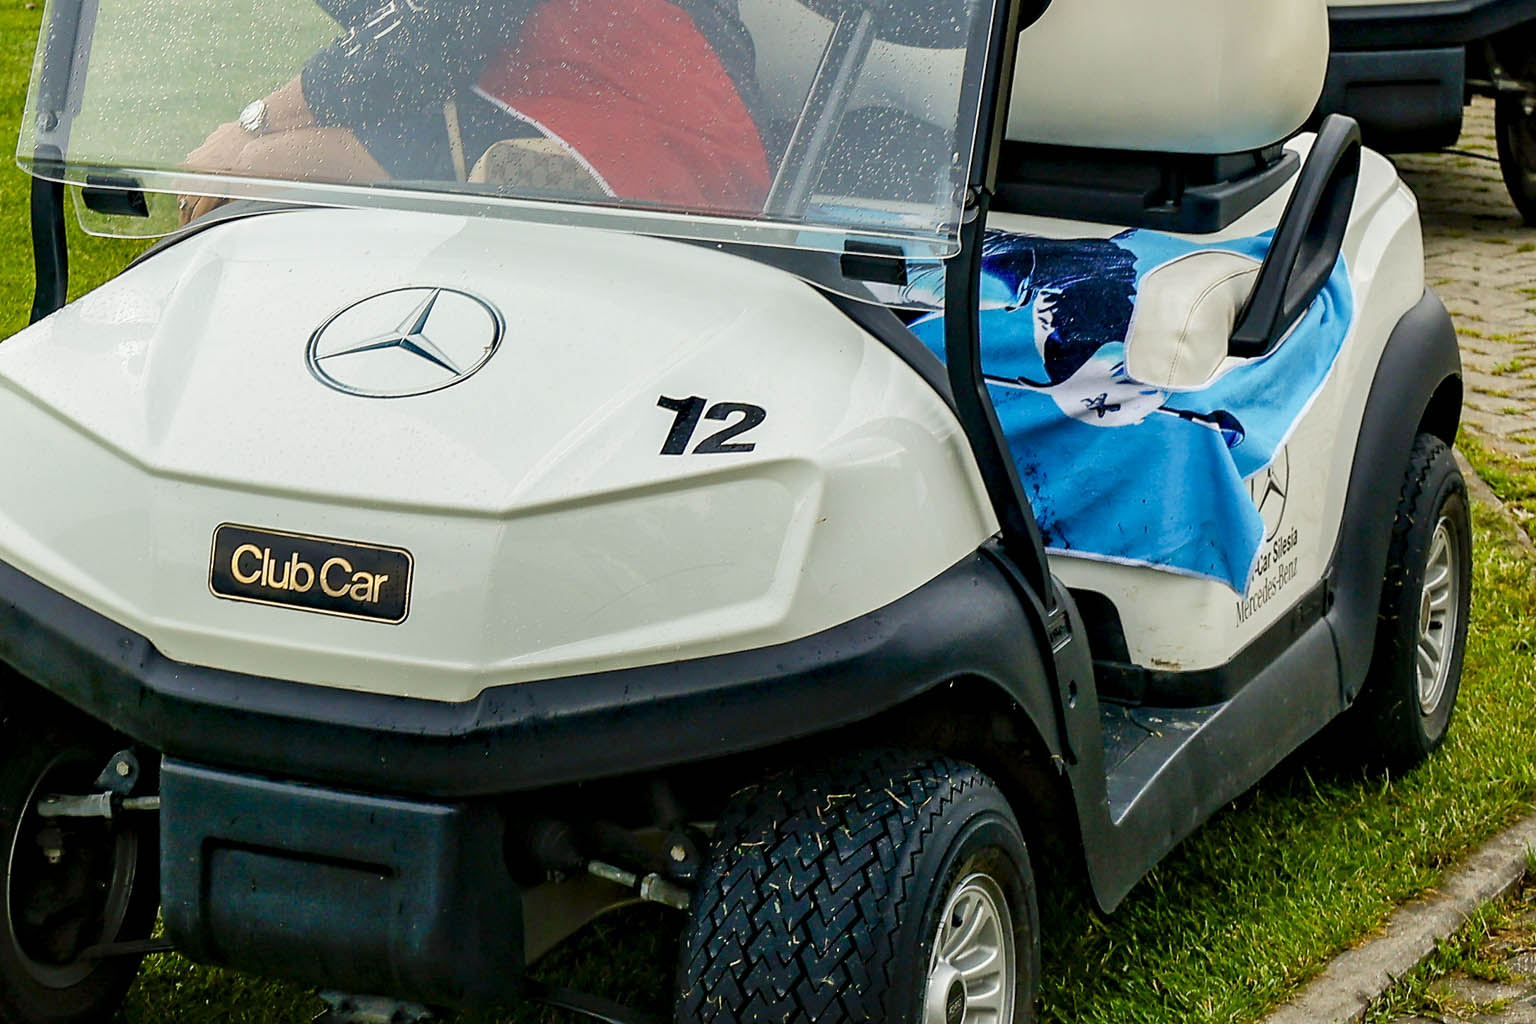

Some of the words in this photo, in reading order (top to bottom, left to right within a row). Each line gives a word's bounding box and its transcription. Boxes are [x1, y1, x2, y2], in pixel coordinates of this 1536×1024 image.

[656, 394, 767, 456] 12
[230, 543, 315, 593] Club
[319, 556, 389, 604] Car
[1273, 525, 1298, 564] Silesia
[1235, 556, 1298, 629] Mercedes-Benz
